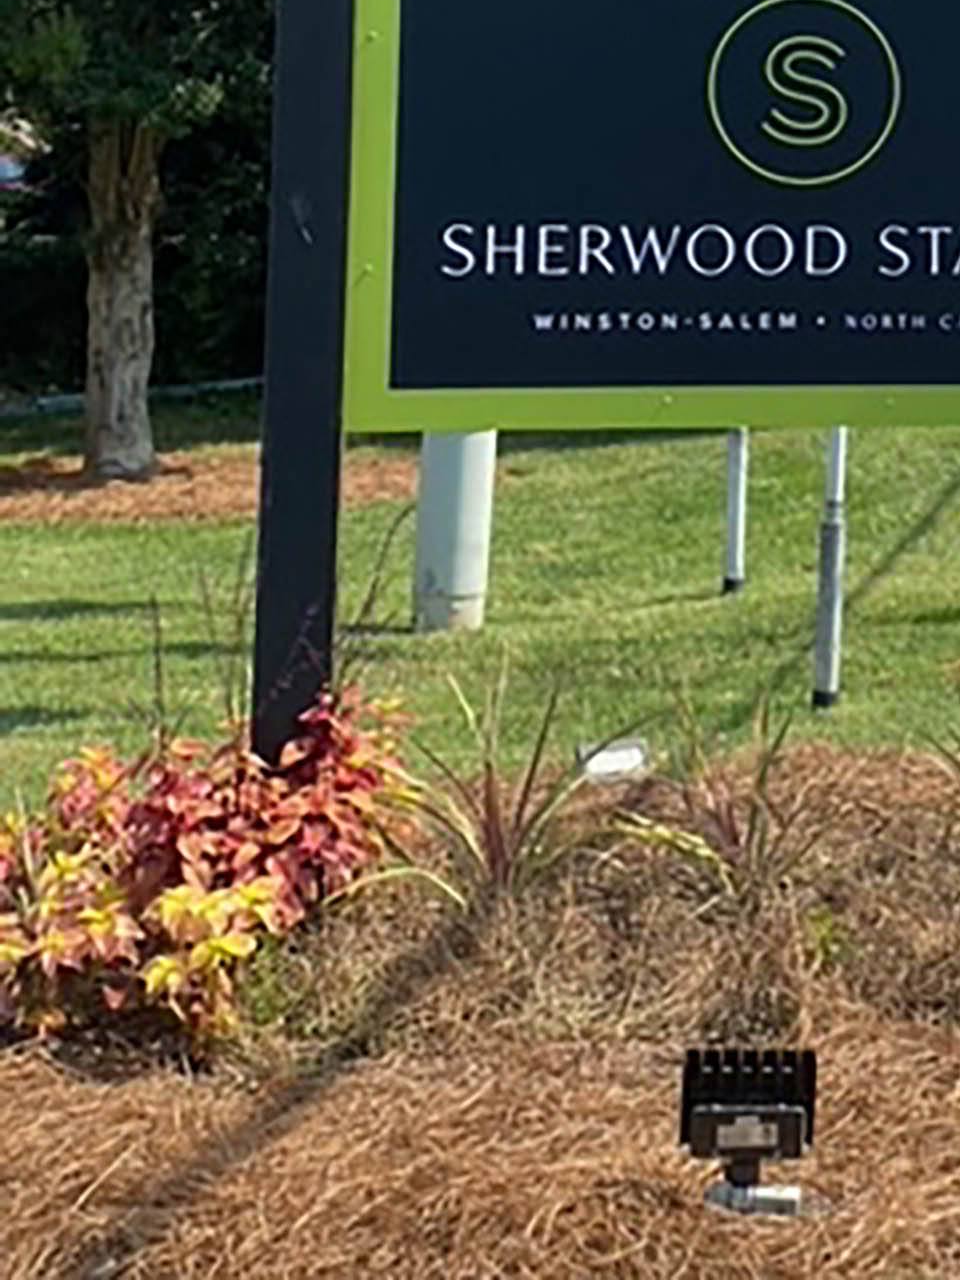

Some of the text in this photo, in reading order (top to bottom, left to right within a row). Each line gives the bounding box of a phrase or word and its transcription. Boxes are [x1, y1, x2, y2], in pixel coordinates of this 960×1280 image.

[761, 35, 848, 146] S
[440, 223, 848, 277] SHERWOOD
[533, 311, 798, 331] WINSTON-SALEM
[844, 313, 926, 330] NORTH
